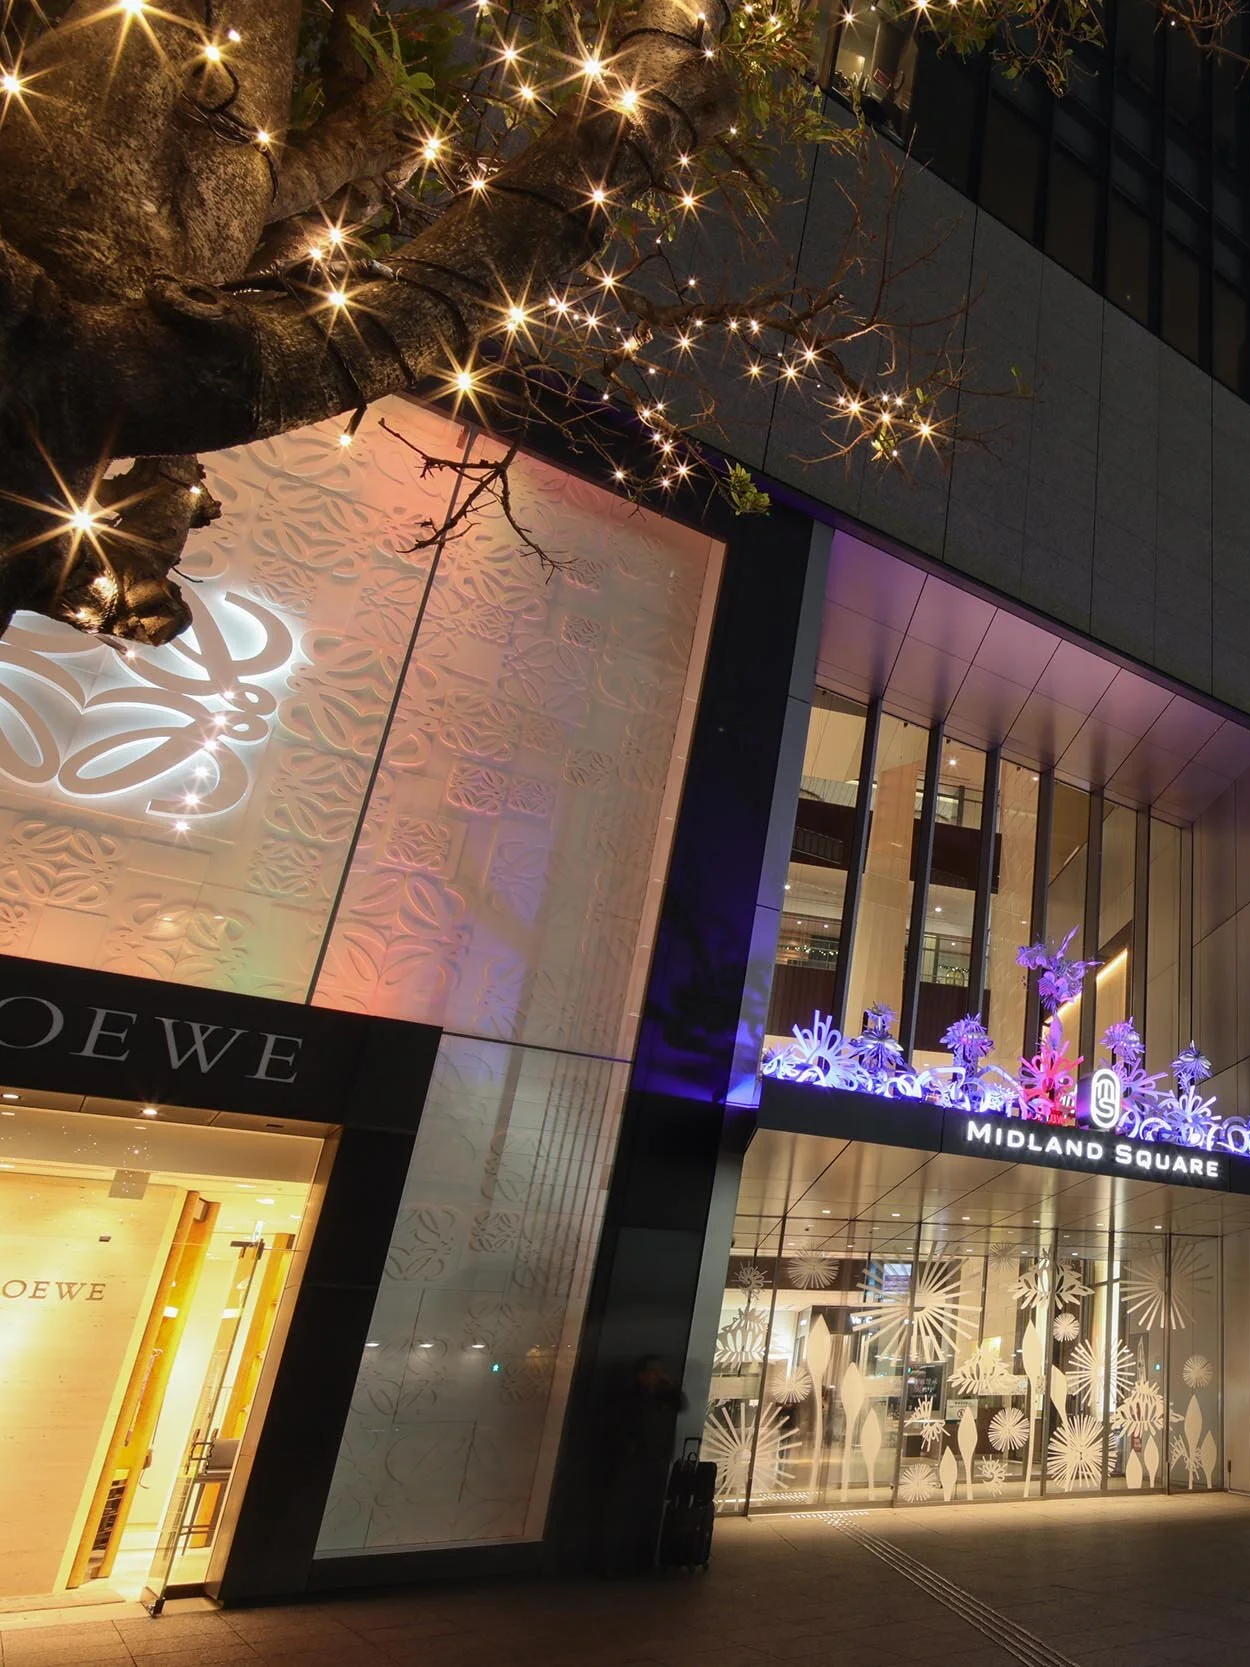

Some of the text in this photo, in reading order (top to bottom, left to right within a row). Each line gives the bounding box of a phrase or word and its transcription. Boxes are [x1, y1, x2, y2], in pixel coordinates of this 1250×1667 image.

[0, 996, 303, 1084] OEWE
[967, 1120, 1219, 1177] MIDLAND SQUARE
[1, 1279, 106, 1301] OEWE
